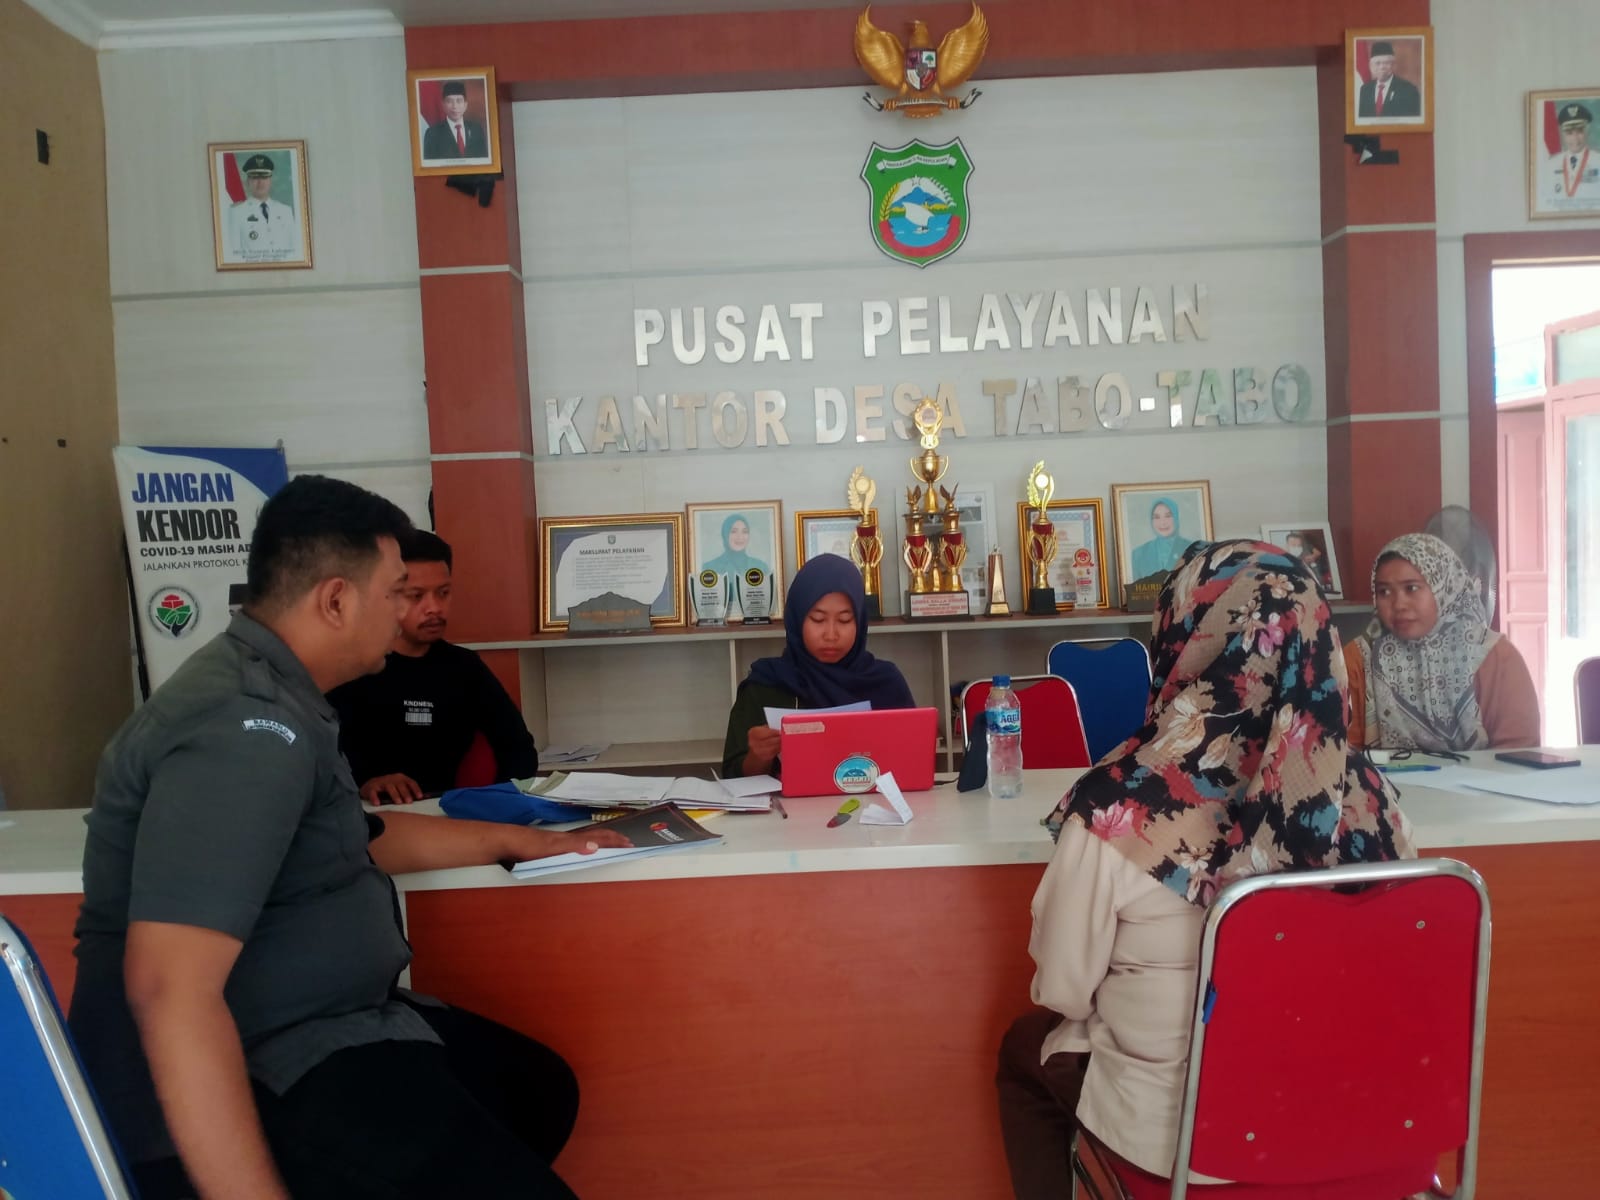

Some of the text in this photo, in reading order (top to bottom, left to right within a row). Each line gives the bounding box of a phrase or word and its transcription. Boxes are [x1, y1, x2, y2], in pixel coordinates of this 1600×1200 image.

[633, 282, 1209, 367] PUSAT PELAYANAN
[544, 362, 1313, 457] KANTOR DESA TABO-TABO
[131, 472, 235, 503] JANGAN
[136, 508, 241, 542] KENDOR
[140, 544, 195, 557] COVID-19
[197, 543, 235, 555] MASIH
[143, 560, 191, 572] JALANKAN
[193, 558, 240, 569] PROTOKOL
